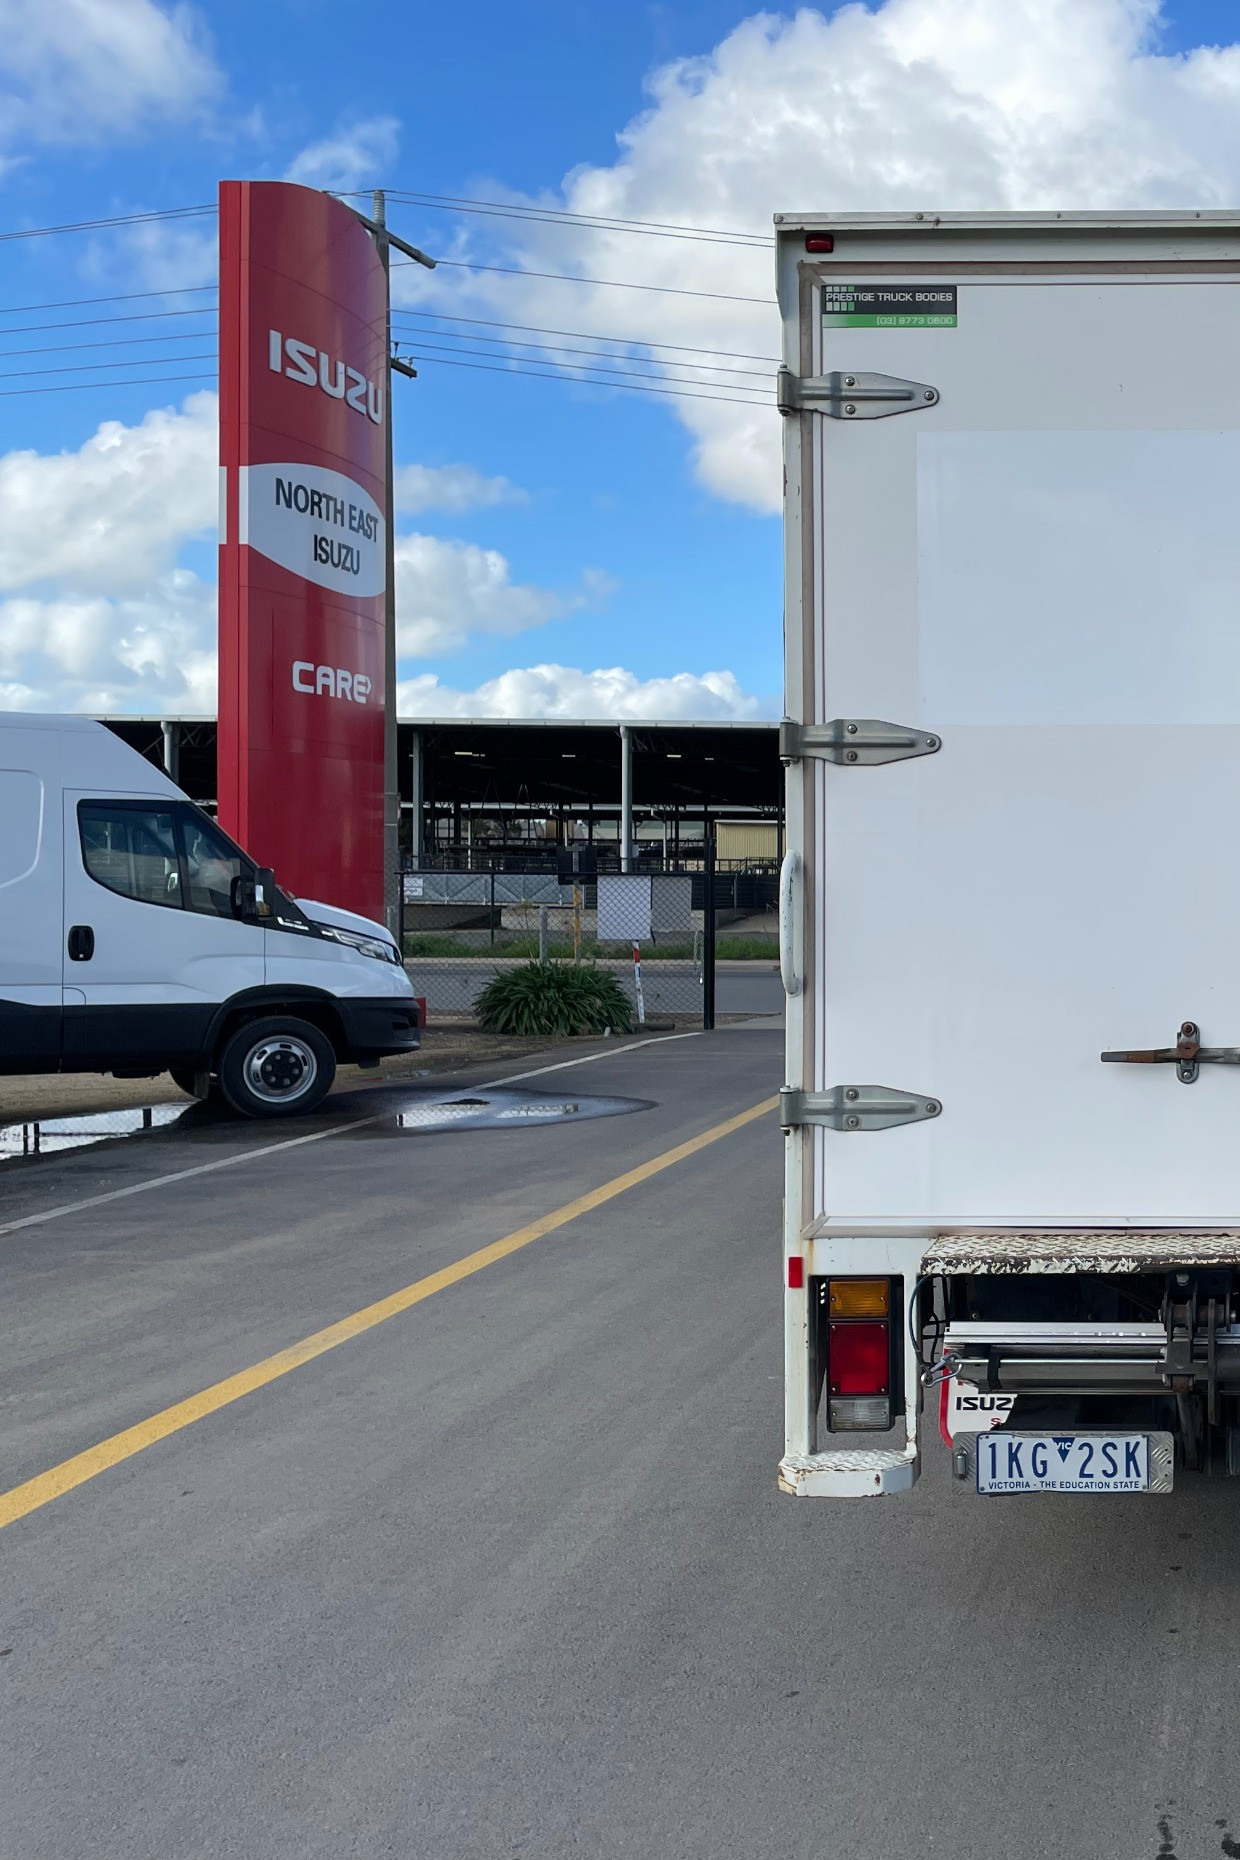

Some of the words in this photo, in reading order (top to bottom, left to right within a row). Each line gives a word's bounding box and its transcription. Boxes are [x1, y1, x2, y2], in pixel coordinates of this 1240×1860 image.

[826, 292, 875, 302] PRESTIGE
[877, 292, 913, 302] TRUCK
[915, 292, 953, 302] BODIES
[876, 316, 896, 326] (03)
[898, 316, 925, 325] 8773
[268, 329, 383, 426] ISUZU
[275, 477, 345, 527] NORTH
[349, 505, 379, 543] EAST
[313, 534, 361, 576] ISUZU
[292, 660, 372, 704] CARE
[956, 1396, 1017, 1411] ISUZ
[1055, 1441, 1072, 1451] VIC
[988, 1441, 1048, 1479] 1KG
[1078, 1441, 1141, 1479] 2SK
[988, 1481, 1030, 1490] VICTORIA
[1040, 1481, 1057, 1489] THE
[1060, 1481, 1110, 1489] EDUCATION
[1113, 1480, 1140, 1489] STATE
